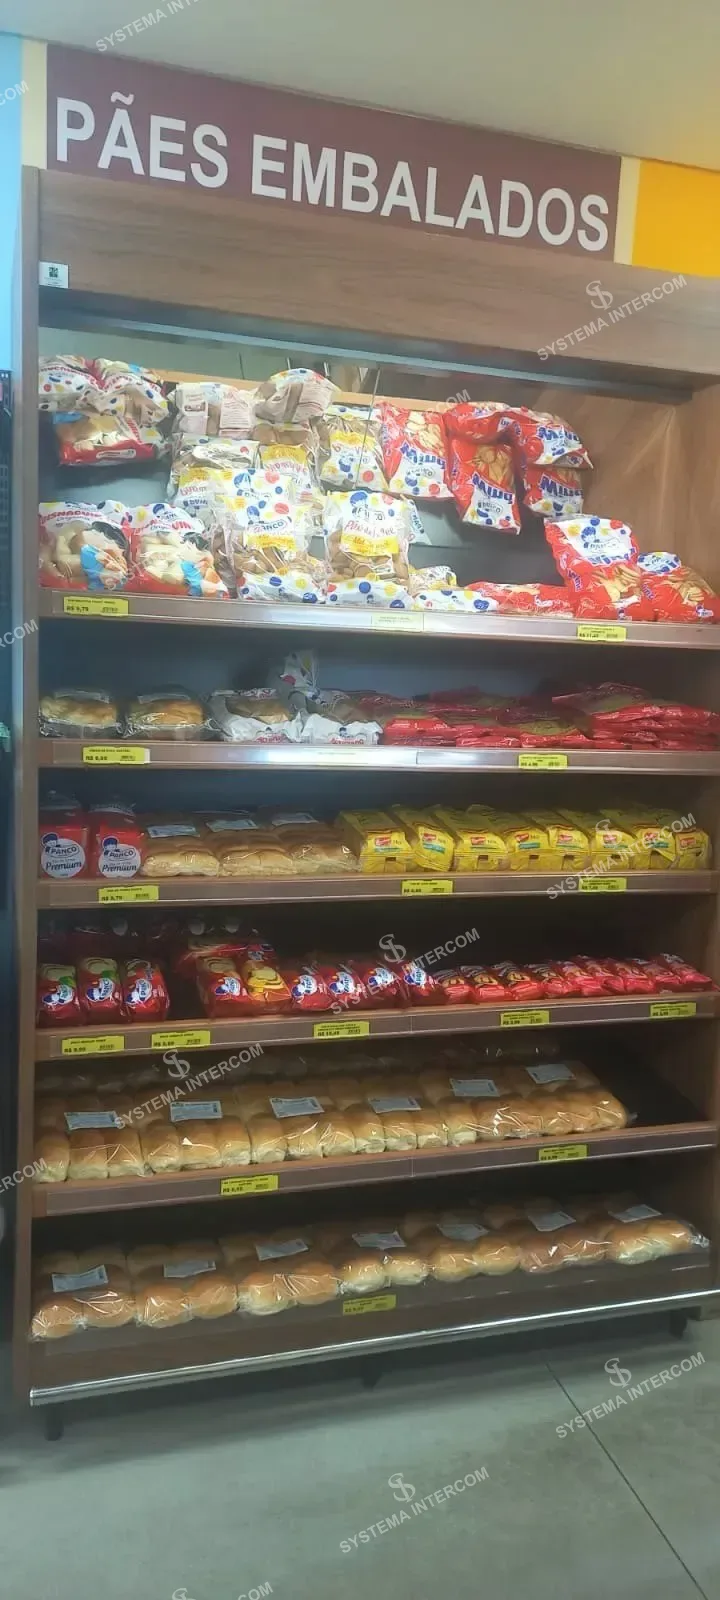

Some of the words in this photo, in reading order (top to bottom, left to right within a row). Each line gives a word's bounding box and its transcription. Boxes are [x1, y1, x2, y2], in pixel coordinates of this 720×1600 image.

[57, 91, 228, 188] PÃES
[251, 134, 609, 251] EMBALADOS
[51, 846, 77, 855] PANCO
[46, 860, 82, 871] Premium
[102, 864, 137, 872] Premium
